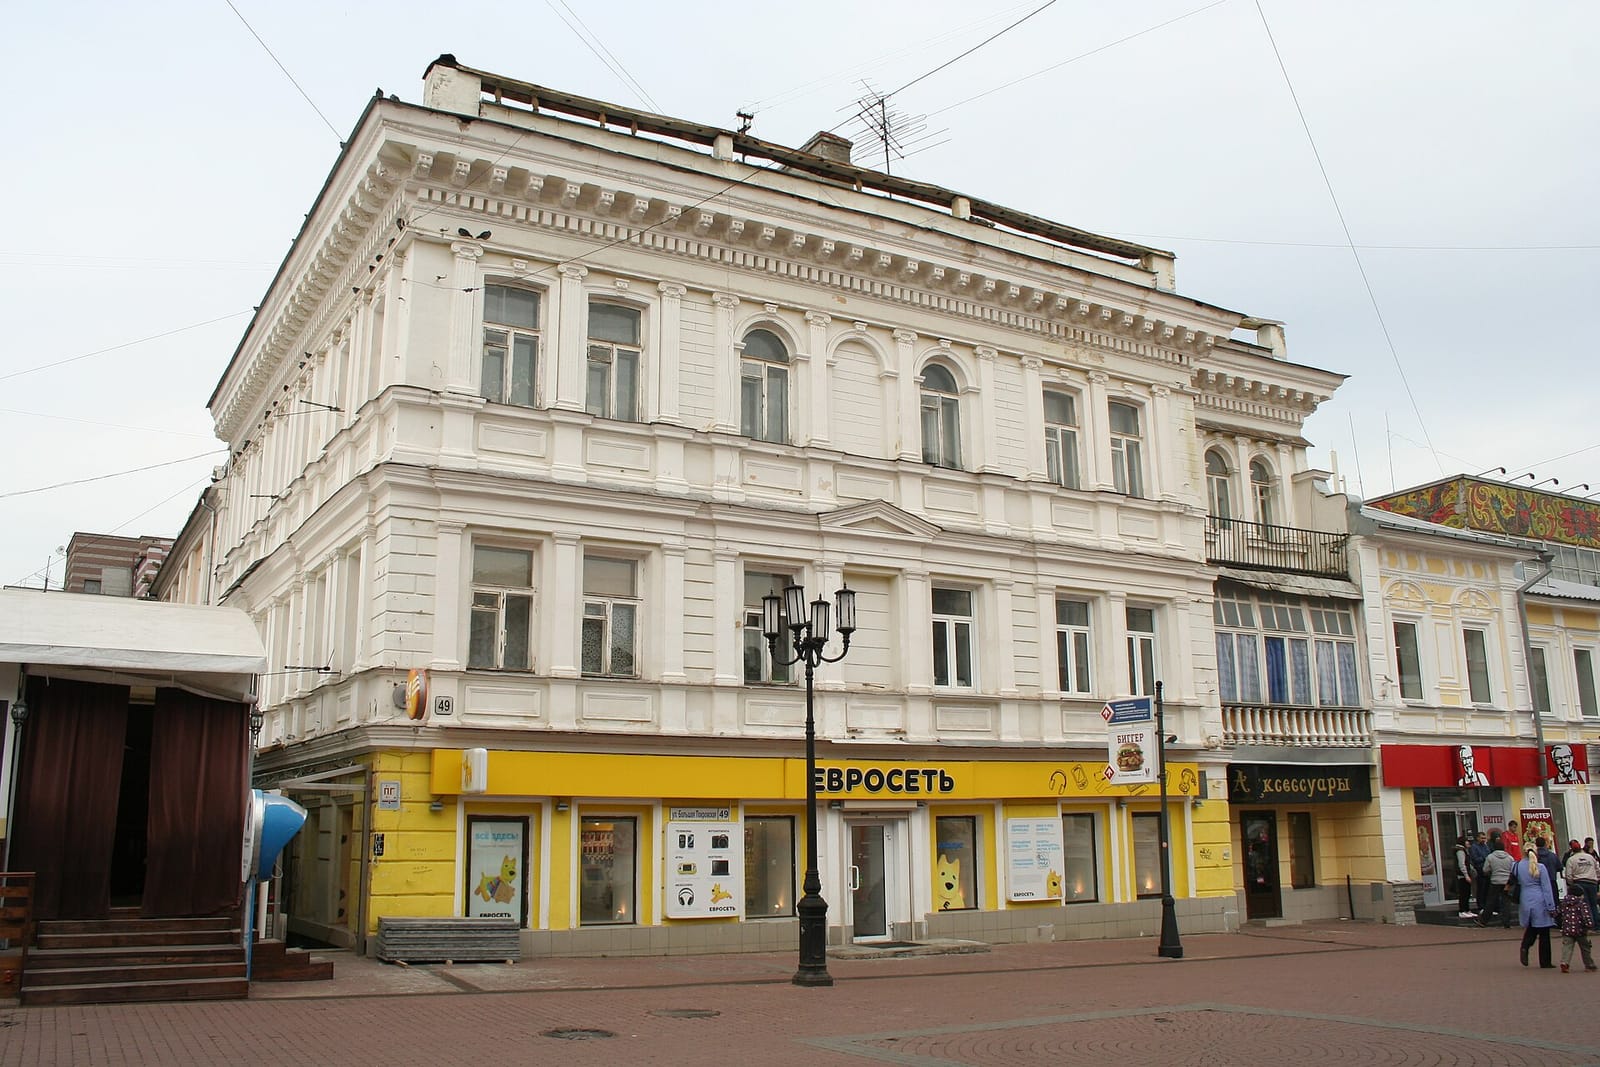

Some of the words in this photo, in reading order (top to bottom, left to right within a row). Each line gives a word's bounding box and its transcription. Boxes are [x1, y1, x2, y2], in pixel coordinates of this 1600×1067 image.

[438, 700, 450, 712] 49
[1117, 733, 1144, 744] БИГГЕР
[815, 768, 954, 792] ЕВРОСЕТЬ
[719, 810, 728, 818] 49
